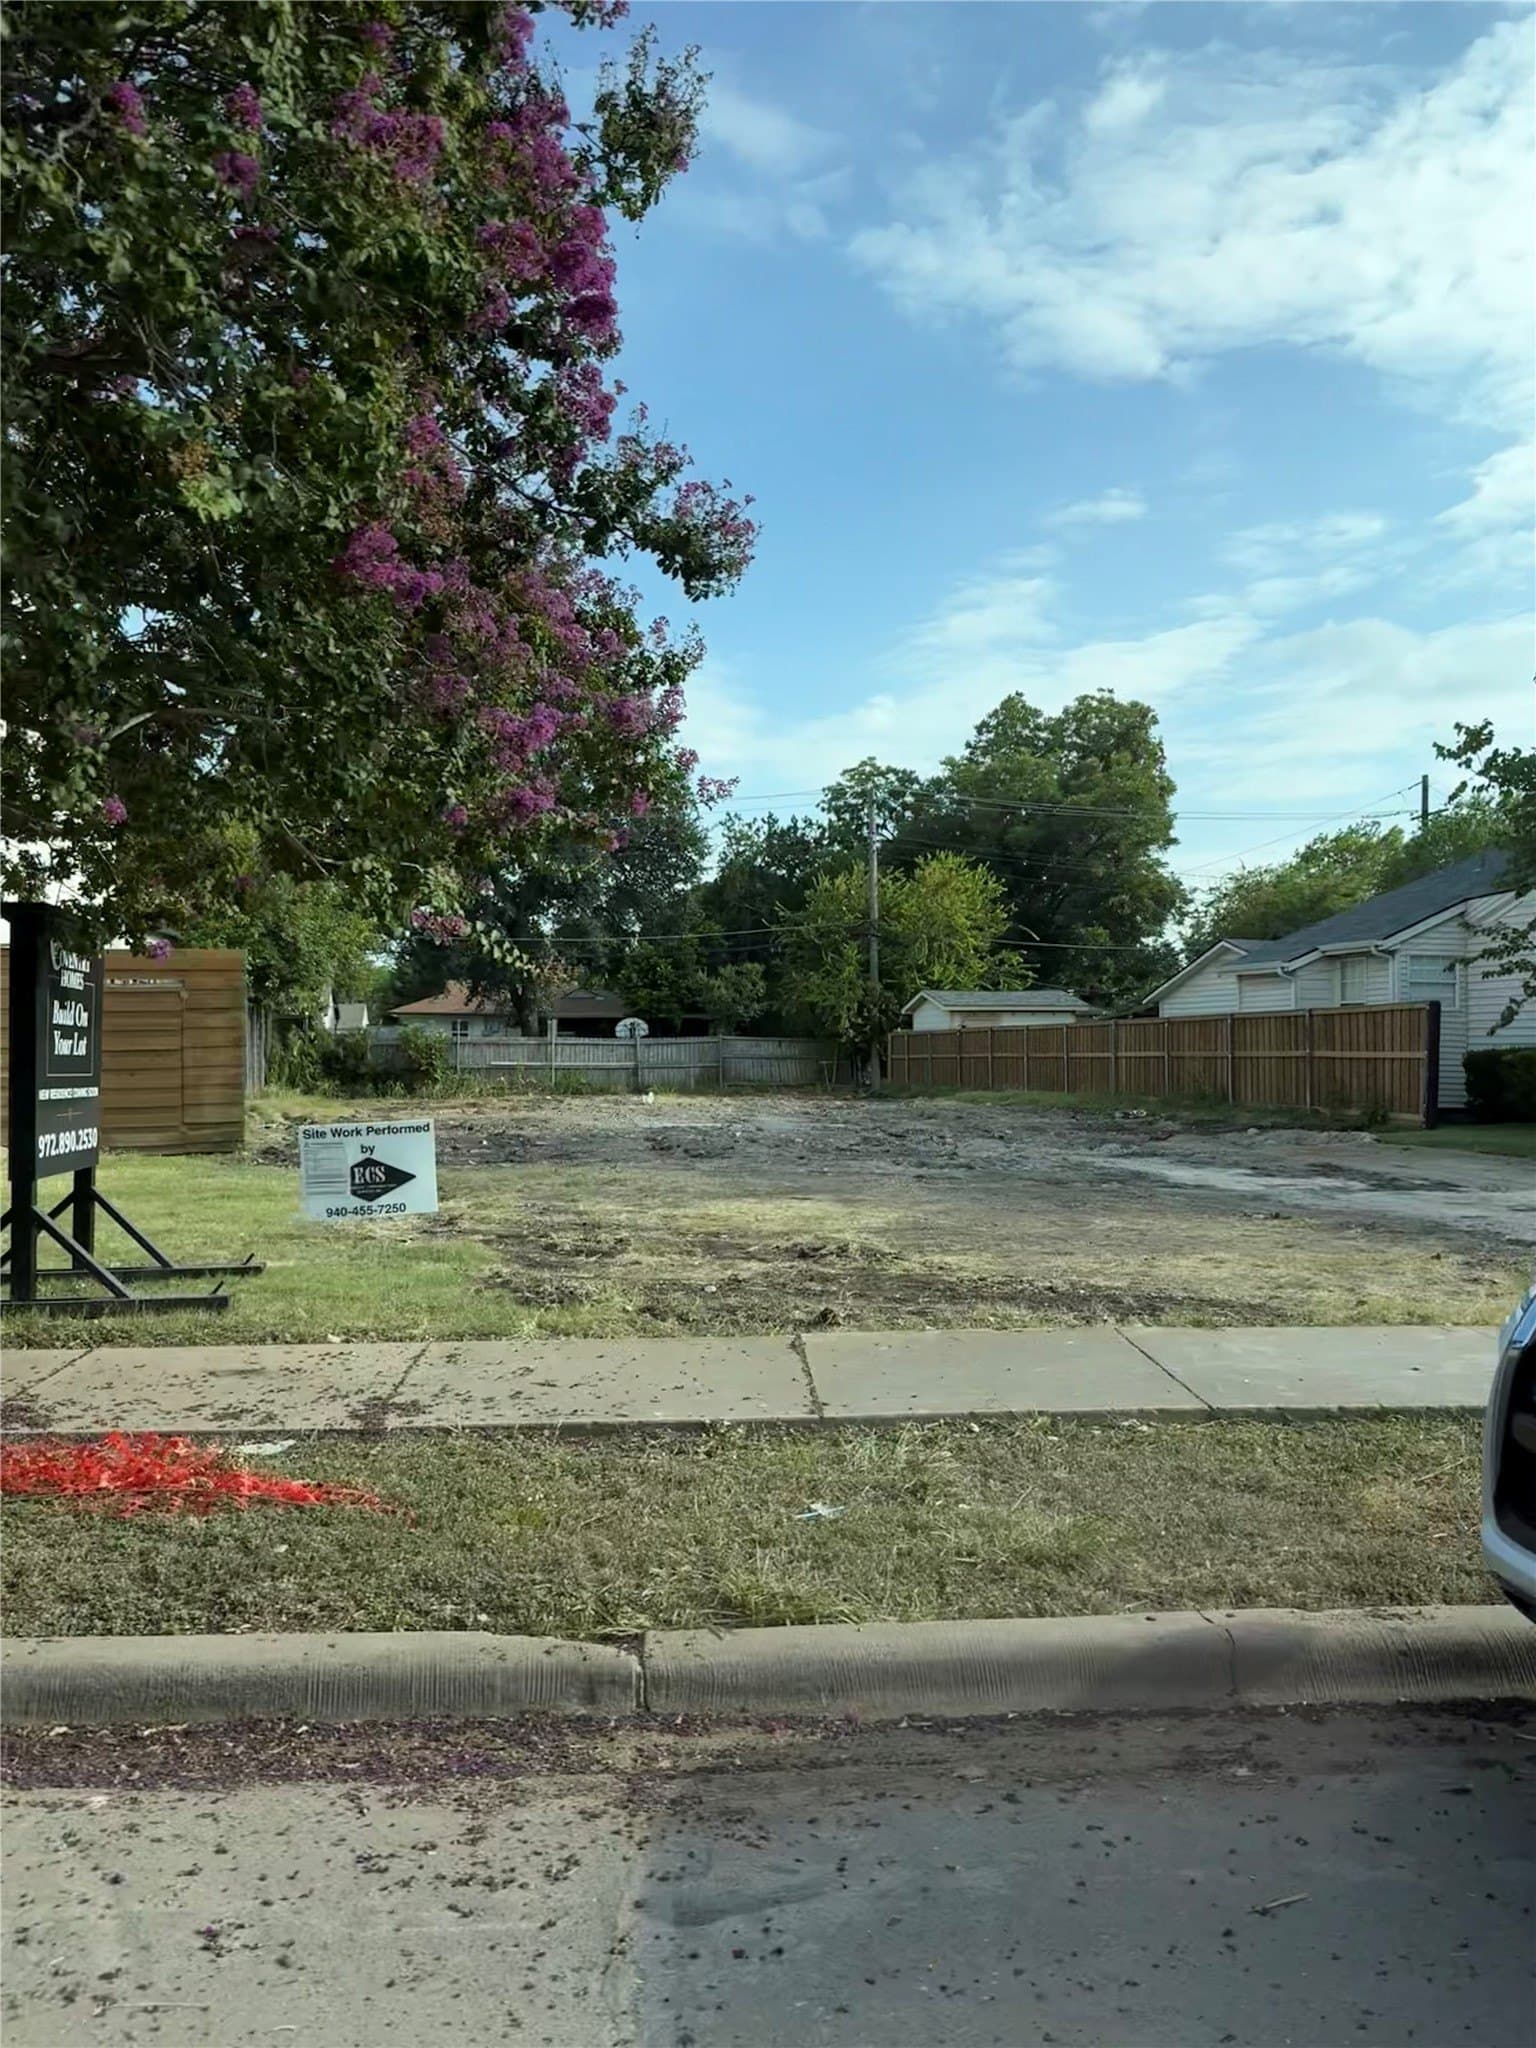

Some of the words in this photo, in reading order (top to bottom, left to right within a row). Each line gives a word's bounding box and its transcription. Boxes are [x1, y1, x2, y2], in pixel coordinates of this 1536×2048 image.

[52, 1000, 75, 1026] Build
[75, 1003, 88, 1027] On
[54, 1030, 72, 1055] Your
[73, 1032, 87, 1056] Lot
[303, 1129, 327, 1139] Site
[330, 1127, 363, 1138] Work
[366, 1123, 430, 1135] Performed
[38, 1127, 98, 1158] 972.890.2530
[360, 1144, 376, 1155] by
[353, 1166, 386, 1185] ECS
[326, 1203, 406, 1218] 940-455-7250
